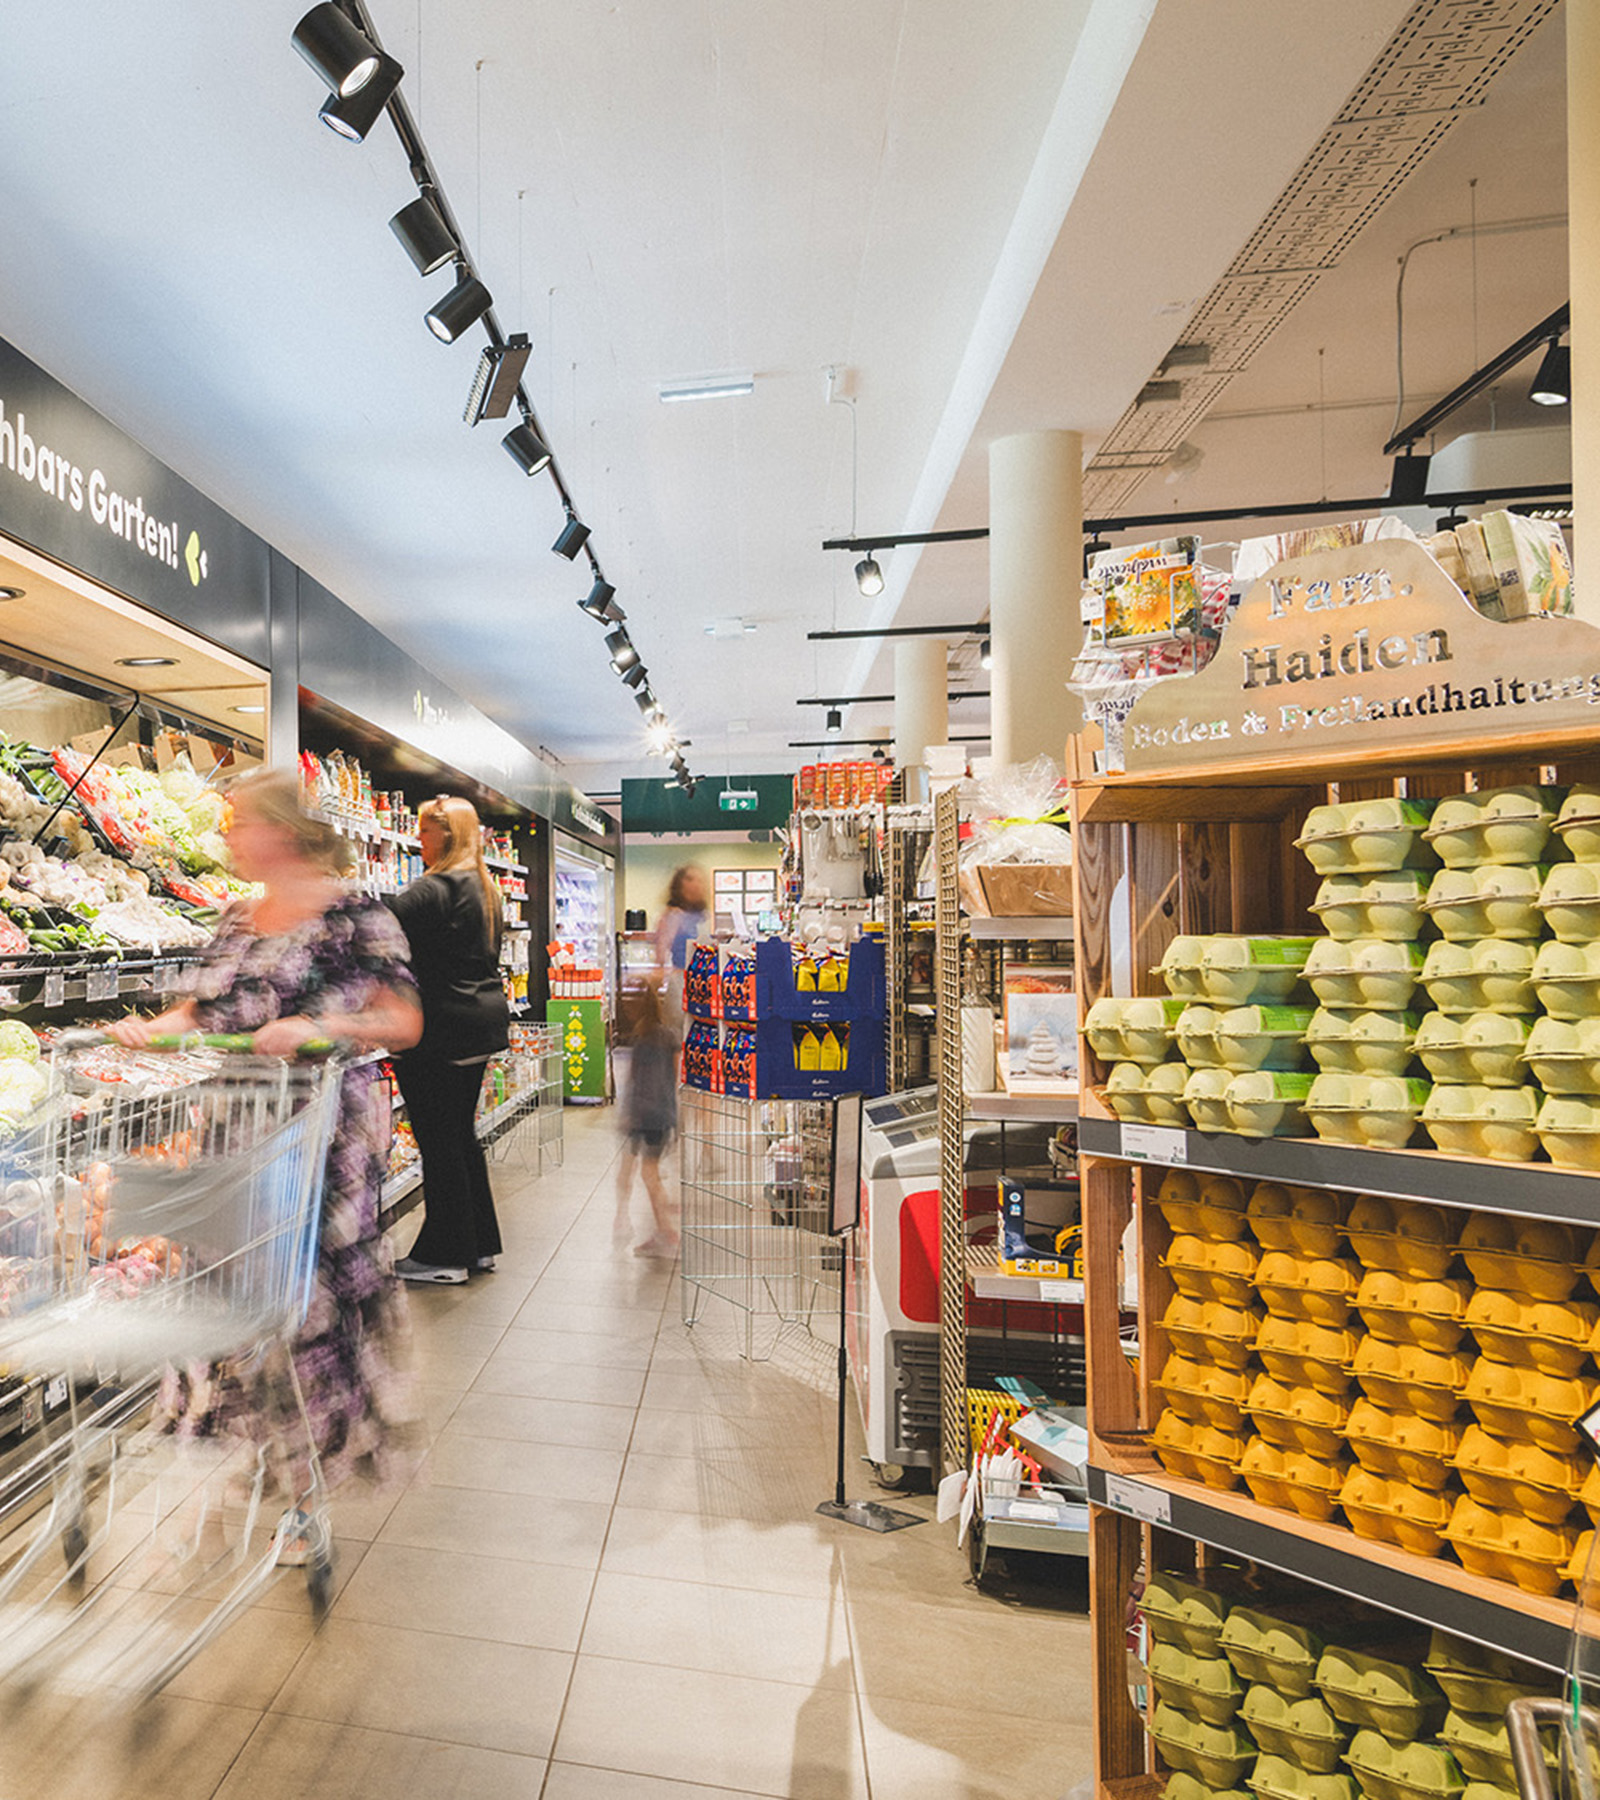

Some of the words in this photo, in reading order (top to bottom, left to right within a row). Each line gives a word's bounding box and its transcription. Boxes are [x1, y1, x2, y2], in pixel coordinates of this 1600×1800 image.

[88, 469, 179, 570] Garten!
[1267, 568, 1414, 621] Fam.
[1241, 627, 1453, 690] Haiden
[1132, 716, 1231, 750] Boden
[1241, 711, 1269, 736] &
